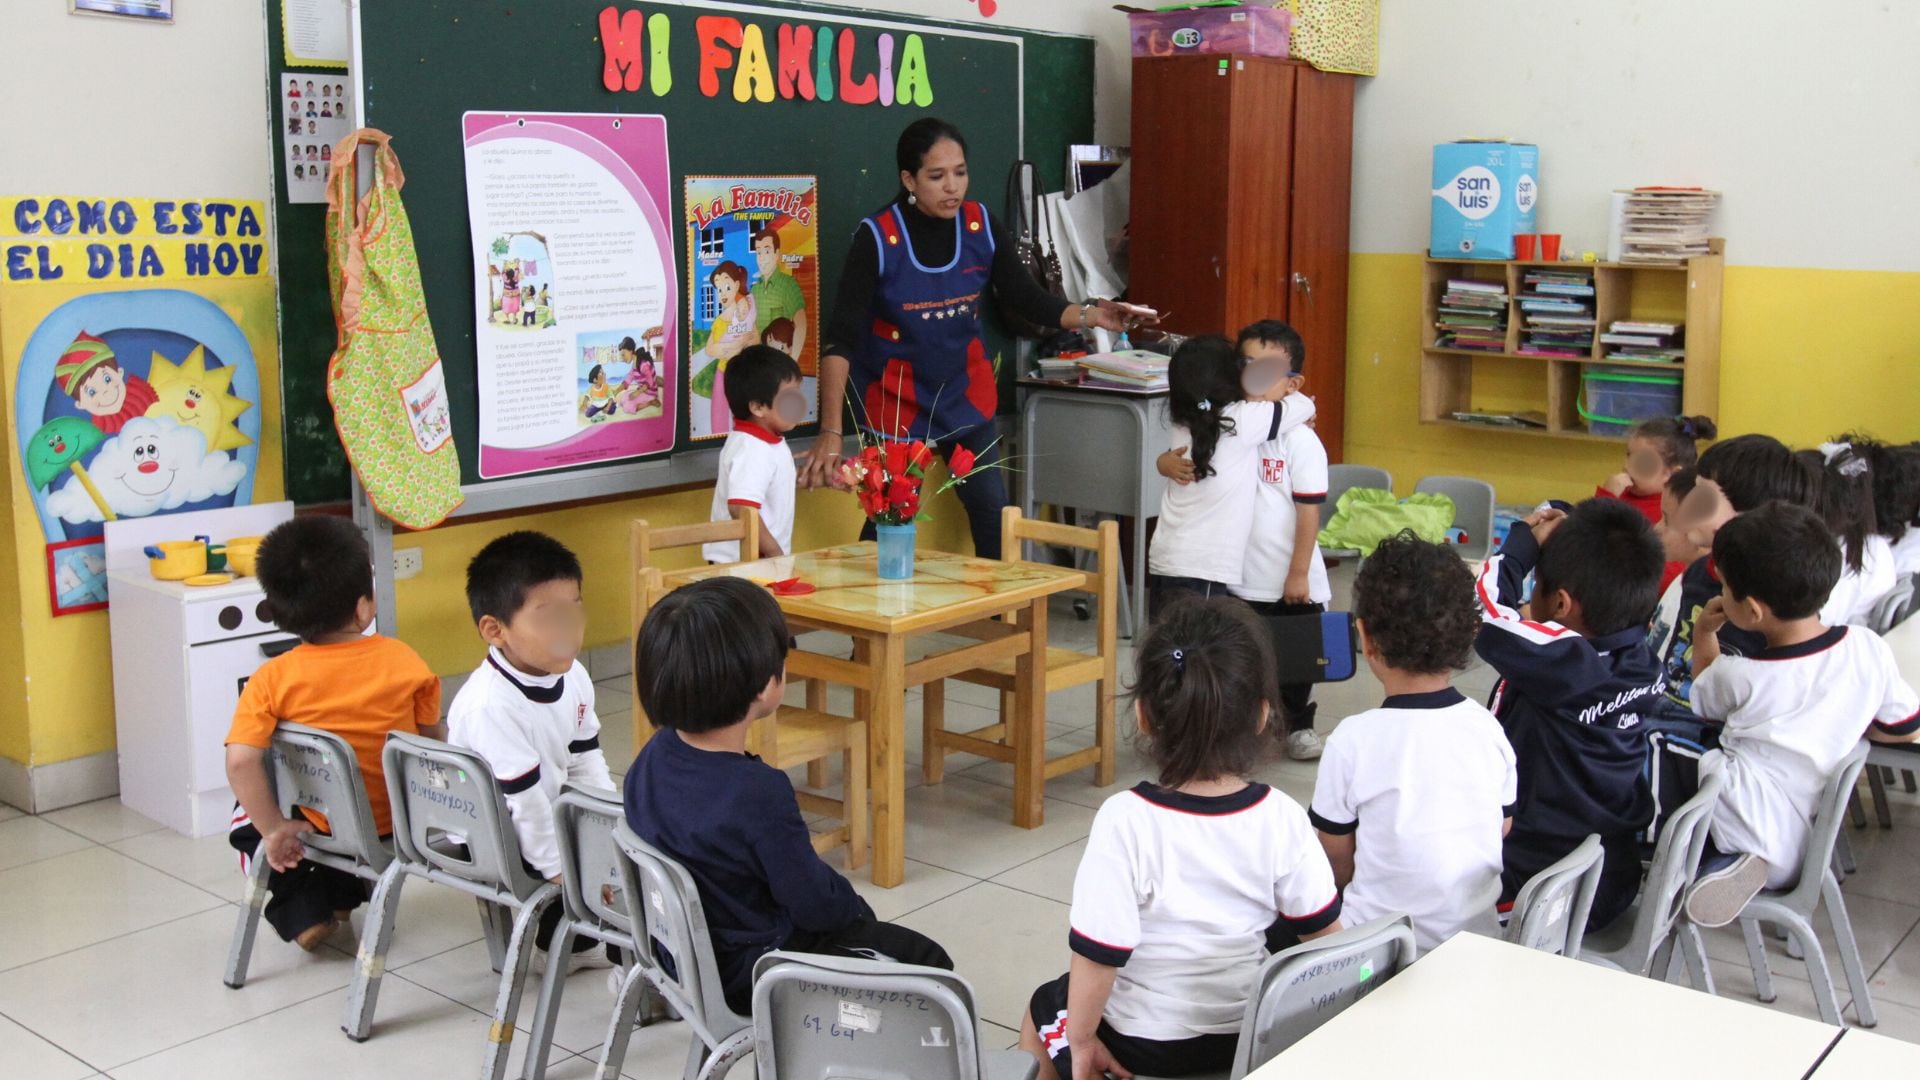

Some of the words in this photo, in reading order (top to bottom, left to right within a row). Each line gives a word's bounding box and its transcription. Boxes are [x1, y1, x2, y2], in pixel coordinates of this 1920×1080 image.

[599, 6, 672, 97] MI
[696, 15, 934, 107] FAMILIA
[1457, 177, 1491, 191] san
[1459, 191, 1489, 209] luis
[14, 199, 138, 235] COMO
[153, 201, 262, 237] ESTA
[694, 197, 725, 231] La
[730, 185, 811, 225] Familia
[6, 245, 64, 281] EL
[86, 243, 165, 280] DIA
[184, 242, 263, 276] HOY
